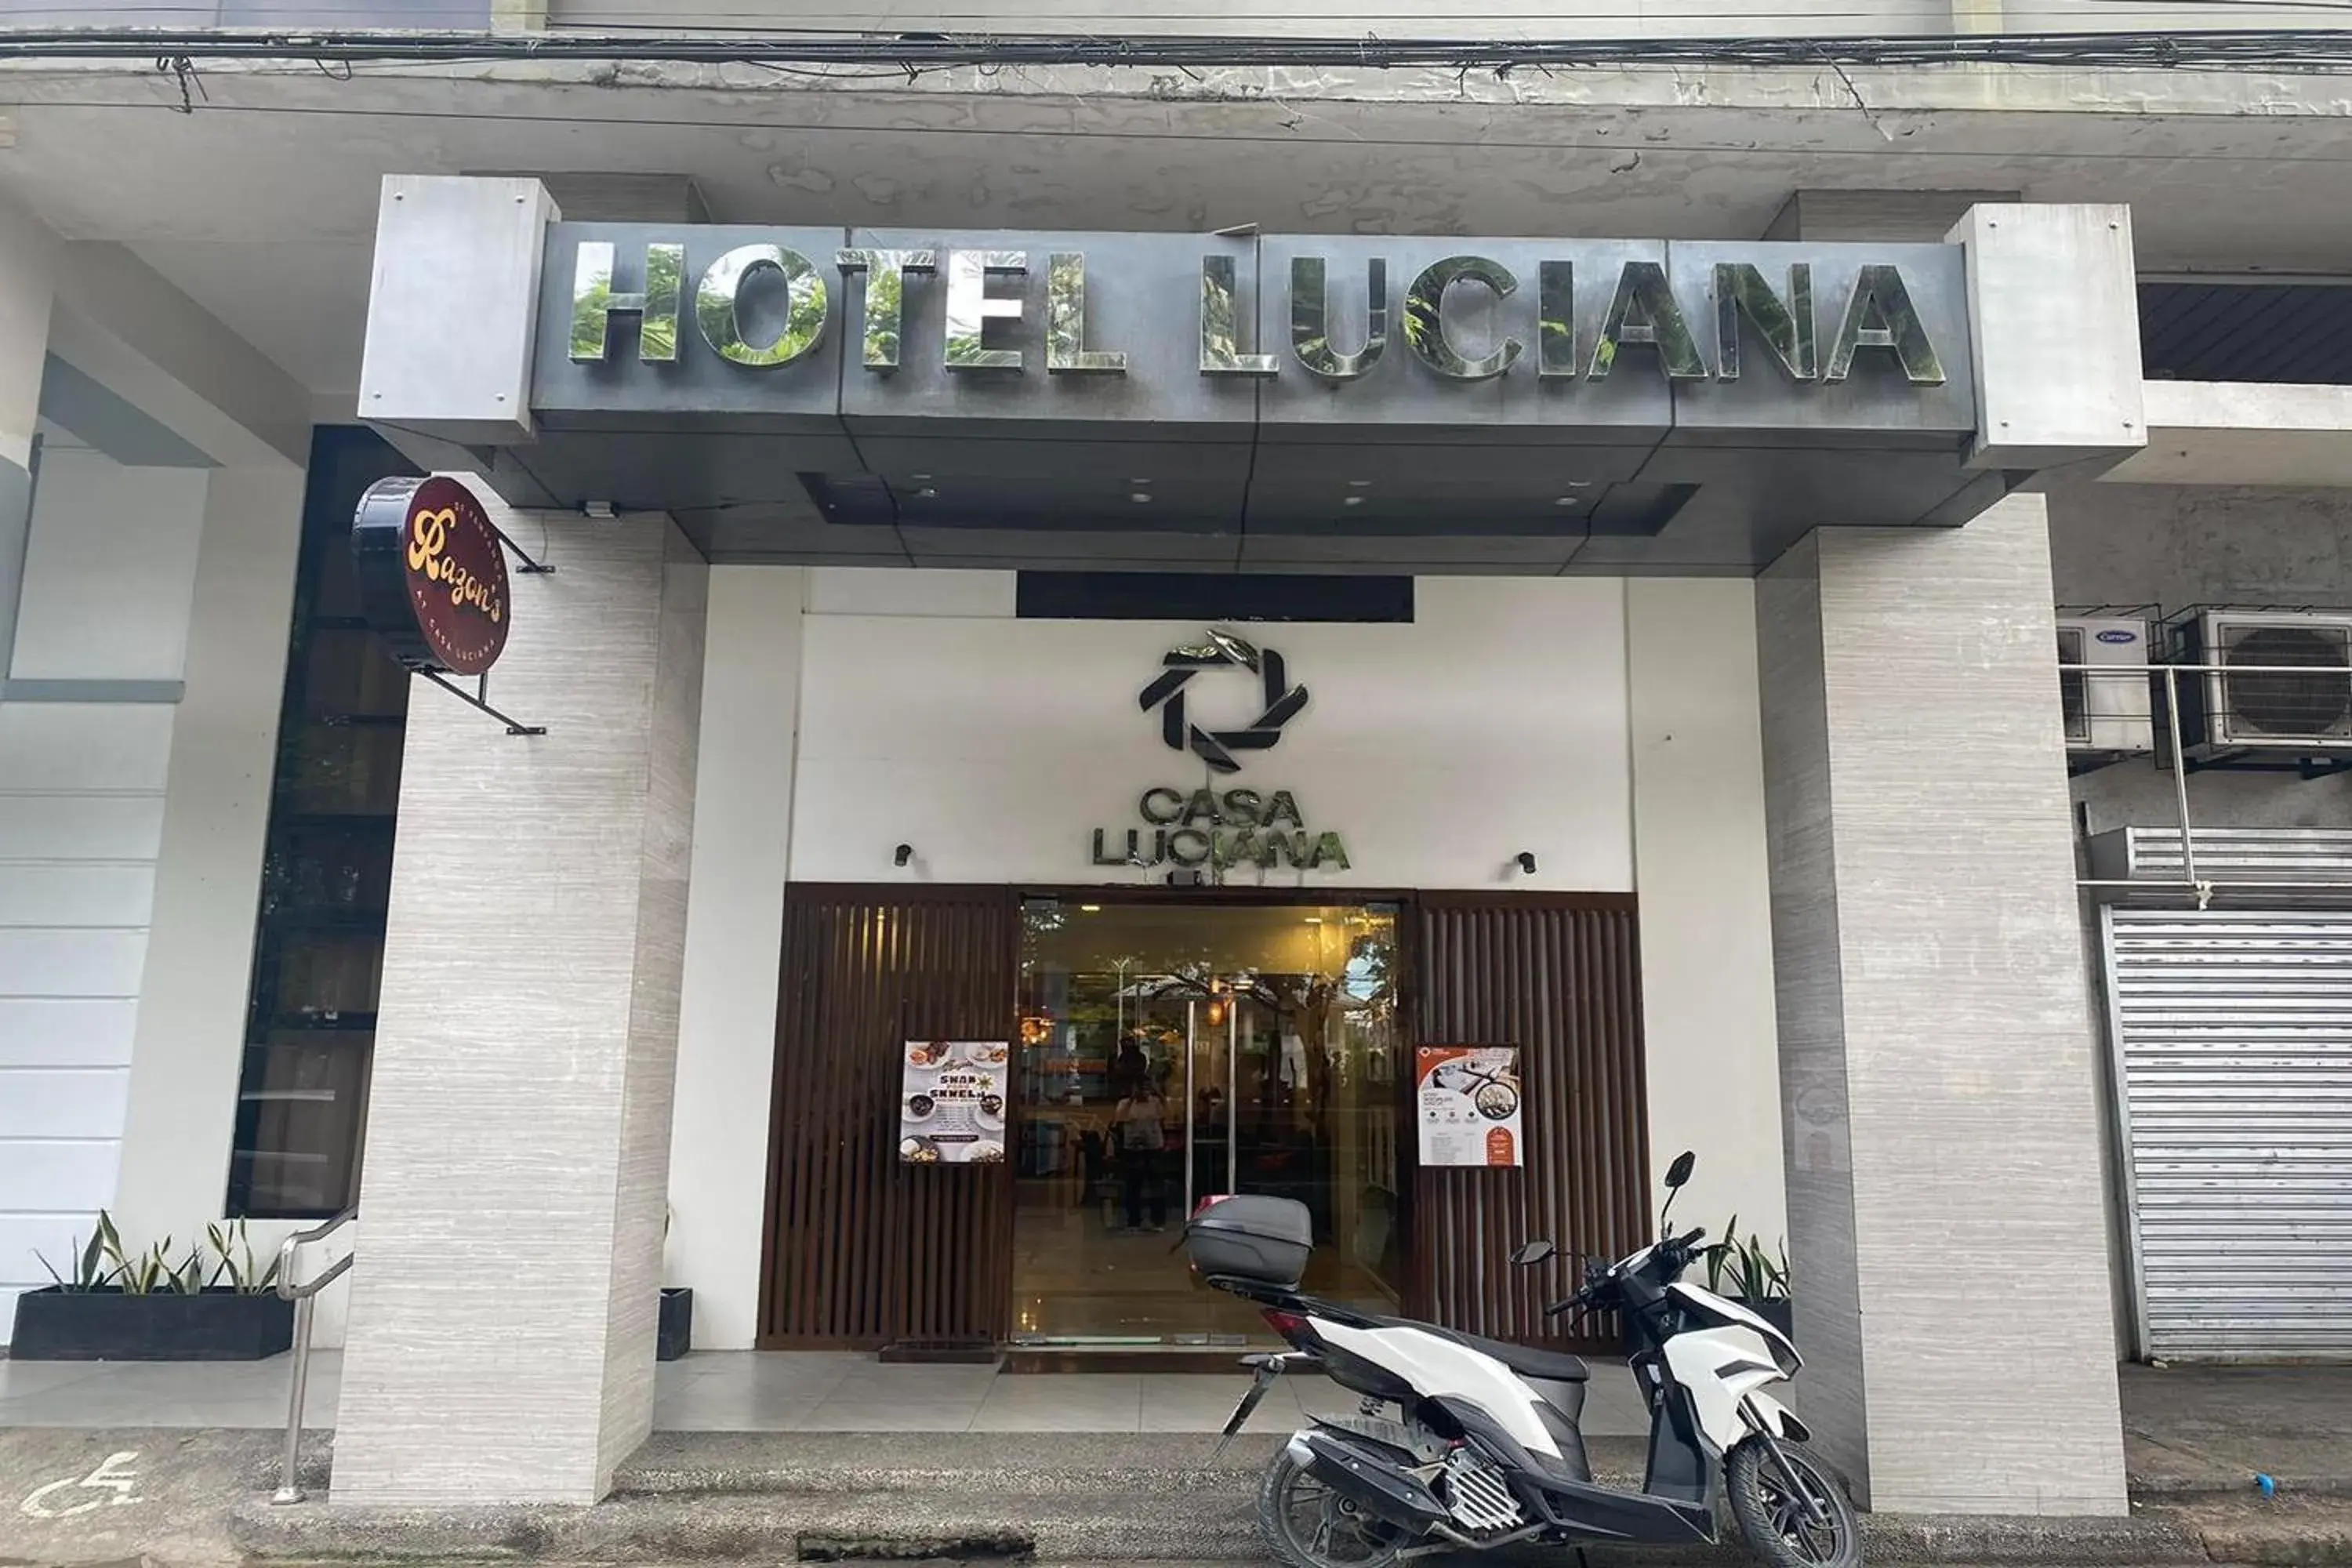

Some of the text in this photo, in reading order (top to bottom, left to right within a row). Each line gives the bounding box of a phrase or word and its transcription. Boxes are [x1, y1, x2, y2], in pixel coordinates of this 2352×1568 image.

[568, 241, 1947, 387] HOTEL LUCIANA
[408, 508, 503, 623] Razon's
[1140, 787, 1305, 828] CASA
[1092, 827, 1352, 870] LUCIANA
